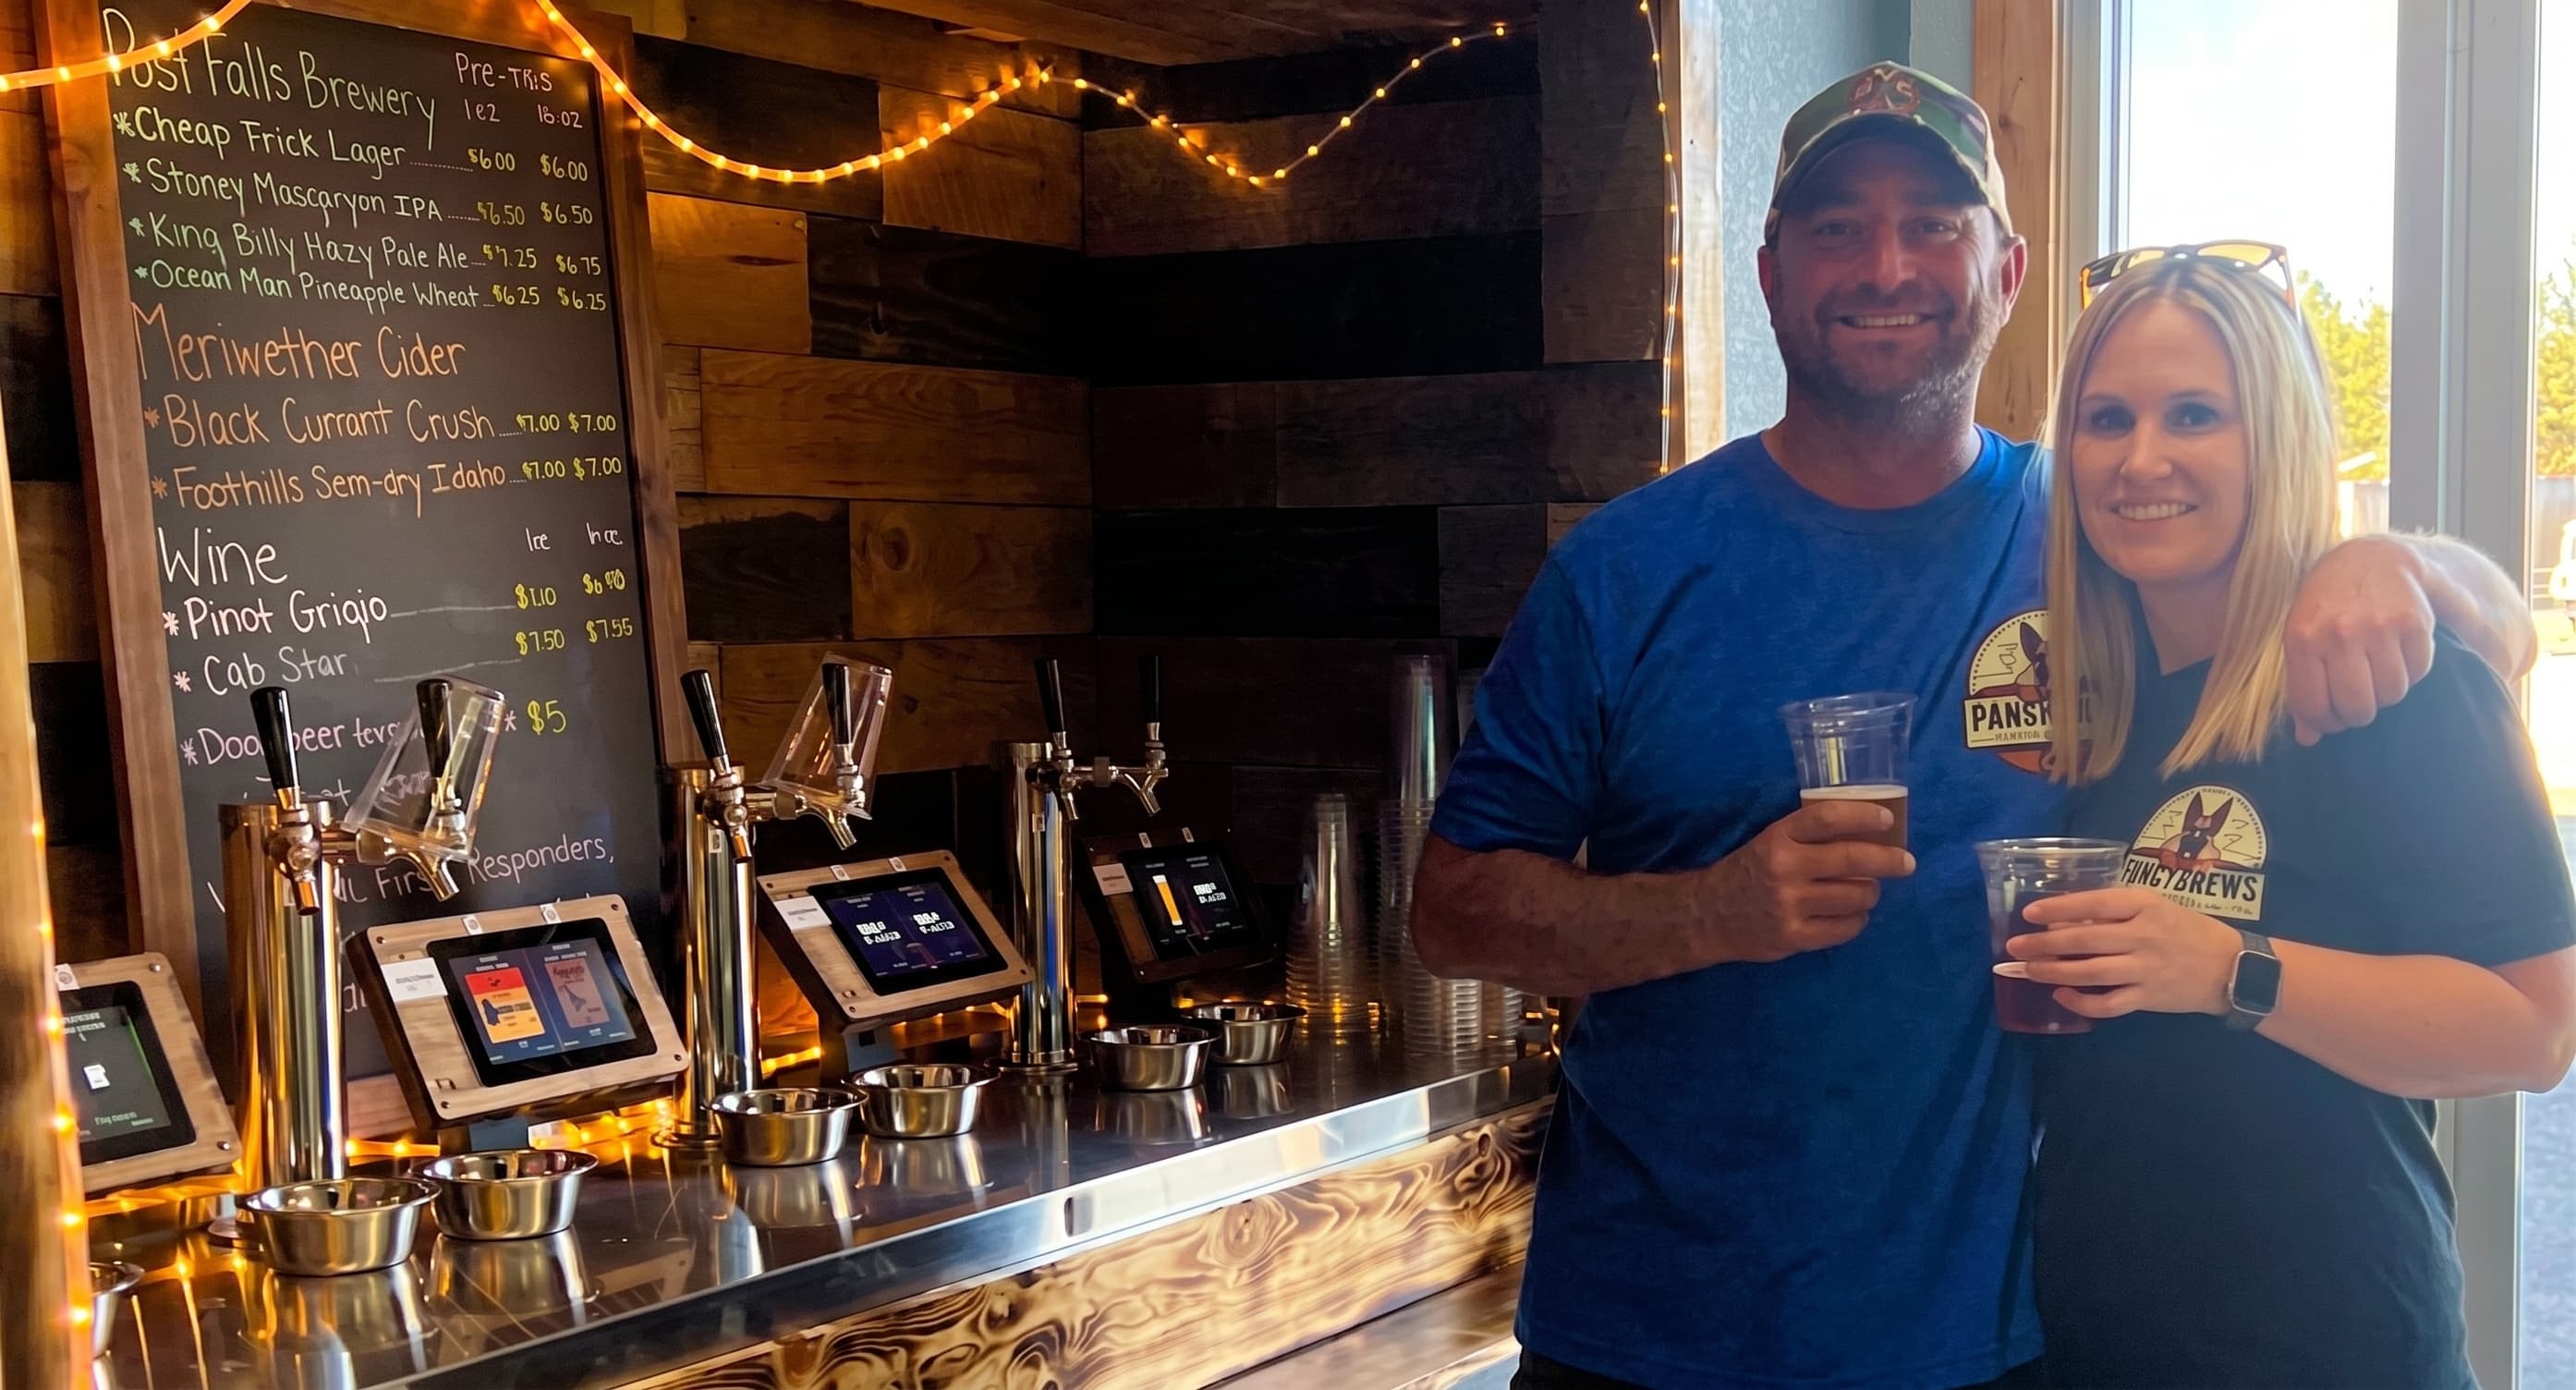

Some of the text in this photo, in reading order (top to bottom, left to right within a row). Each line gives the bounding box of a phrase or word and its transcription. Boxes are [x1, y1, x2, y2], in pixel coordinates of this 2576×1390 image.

[203, 32, 291, 102] Falls
[298, 50, 435, 152] Brewery
[134, 106, 231, 160] Cheap
[239, 120, 320, 158] Frick
[328, 128, 407, 180] Lager
[146, 157, 246, 218] Stoney
[393, 193, 443, 222] IPA
[541, 201, 592, 225] $6.50
[149, 211, 227, 270] King
[232, 223, 296, 275] Billy
[303, 231, 374, 280] Hazy
[381, 236, 430, 268] Pale
[437, 241, 469, 269] Ale
[151, 259, 232, 290] Ocean
[239, 266, 293, 299] Man
[298, 271, 407, 315] Pineapple
[412, 281, 480, 308] Wheat
[130, 302, 466, 381] Meriwether Cider
[164, 393, 270, 447] Black
[281, 396, 393, 445] Currant
[406, 398, 495, 444] Crush
[567, 412, 616, 433] $7.00
[174, 463, 304, 510] Foothills
[428, 460, 505, 494] Idaho
[573, 457, 622, 482] $7.00
[157, 525, 288, 587] Wine
[184, 596, 274, 640] Pinot
[204, 652, 265, 696] Cab
[278, 645, 347, 682] Star
[516, 631, 565, 655] $7.50
[526, 699, 567, 736] $5
[375, 866, 432, 899] Firs
[468, 833, 615, 886] Responders,
